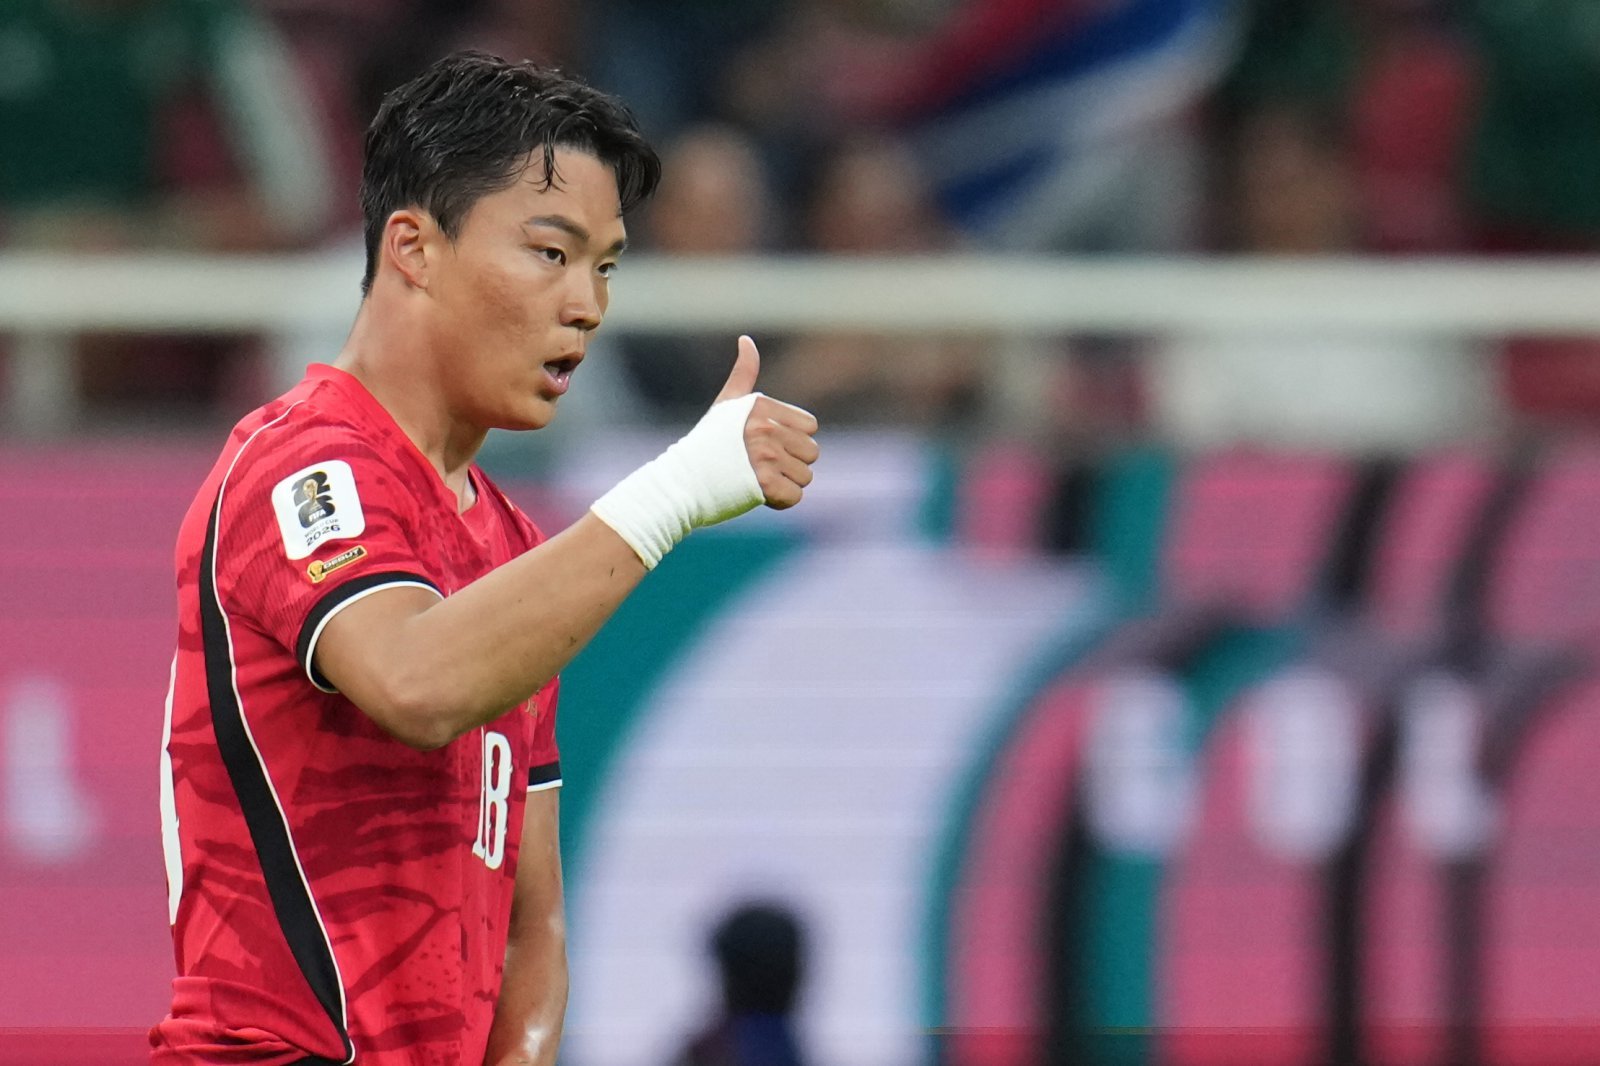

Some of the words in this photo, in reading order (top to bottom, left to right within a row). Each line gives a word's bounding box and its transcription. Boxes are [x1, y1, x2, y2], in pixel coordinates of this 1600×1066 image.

[306, 524, 341, 546] 2026
[323, 548, 359, 570] DEBUT
[472, 726, 513, 870] 18
